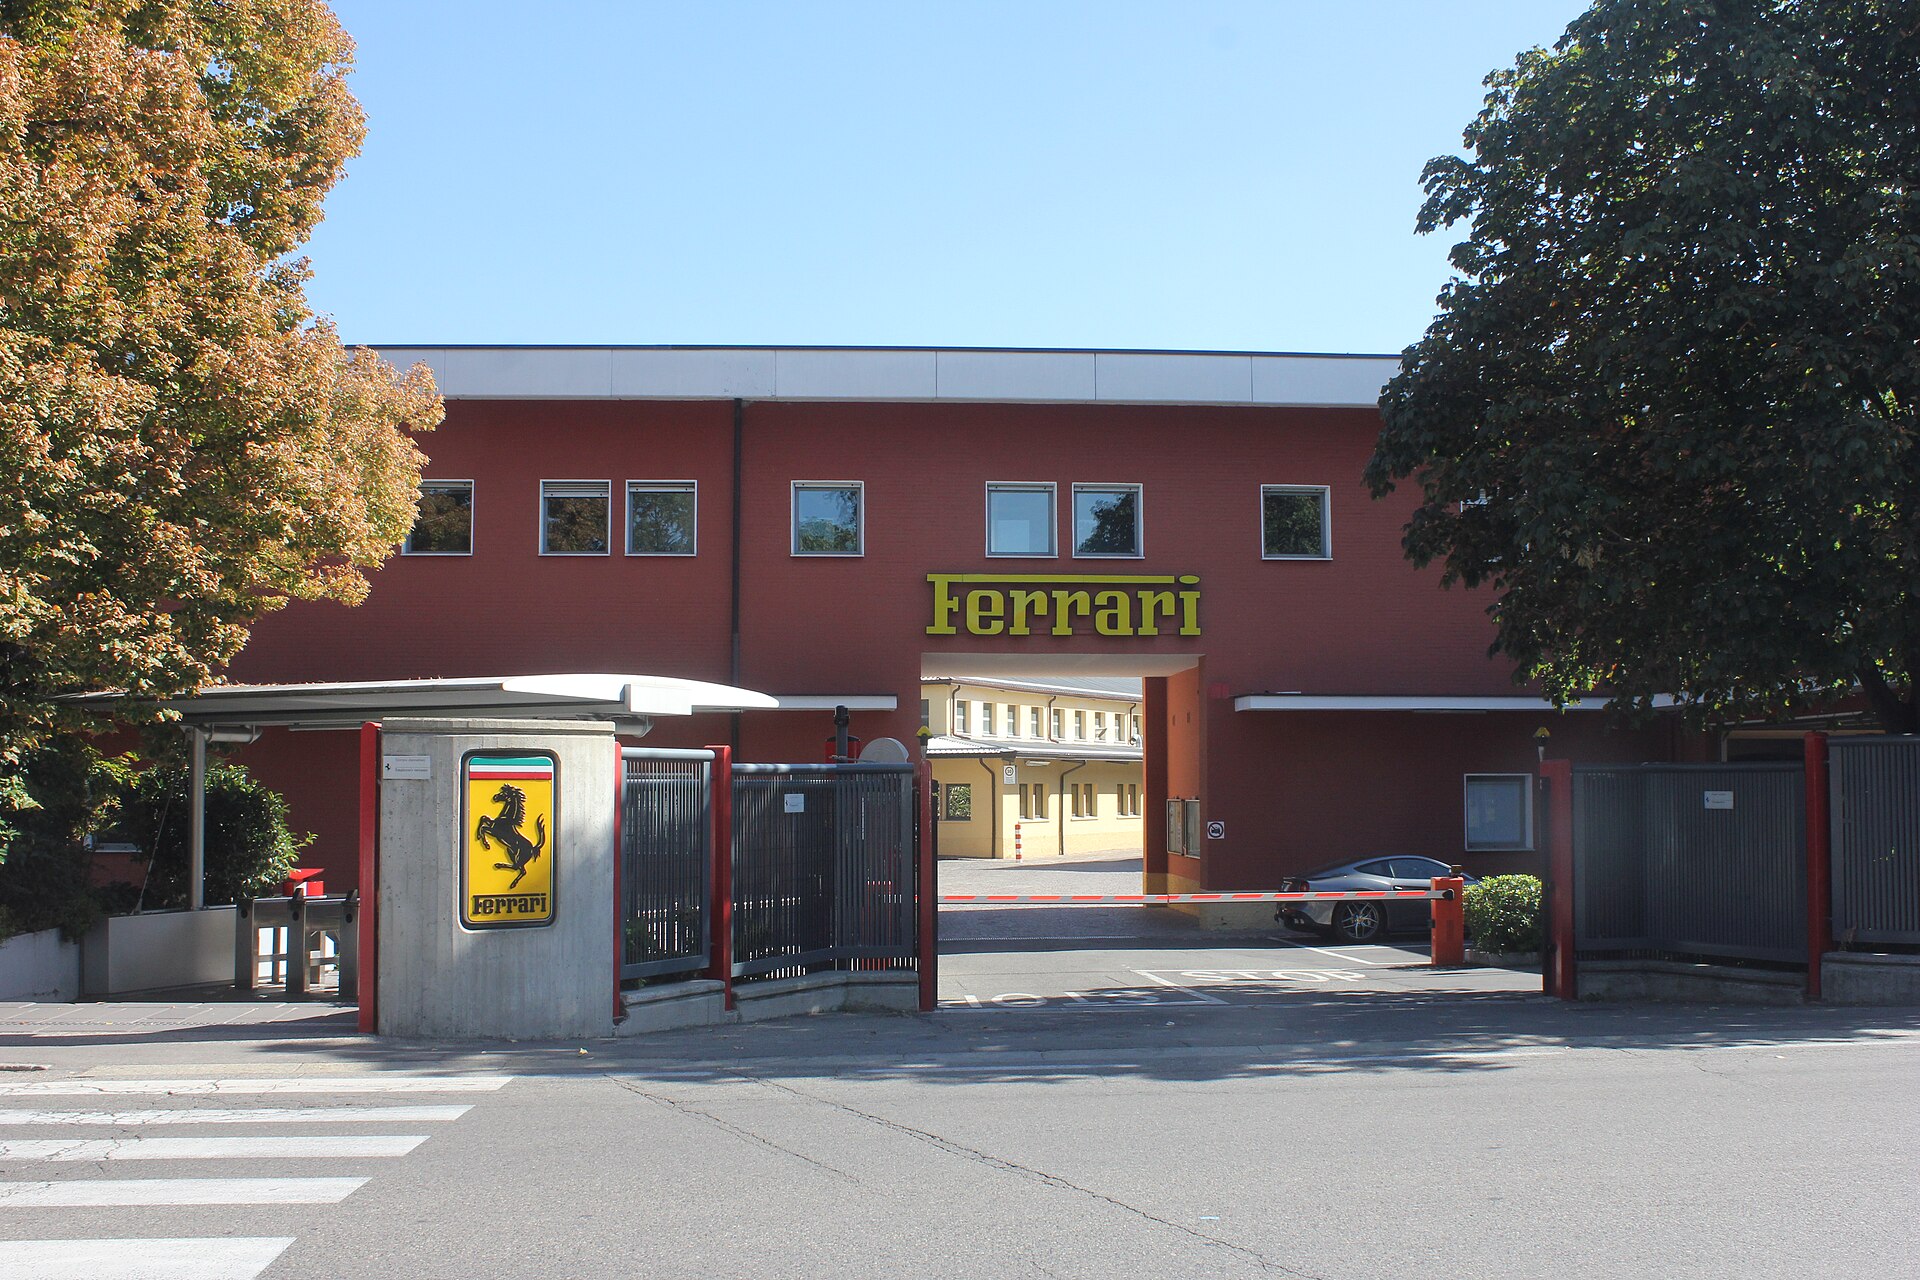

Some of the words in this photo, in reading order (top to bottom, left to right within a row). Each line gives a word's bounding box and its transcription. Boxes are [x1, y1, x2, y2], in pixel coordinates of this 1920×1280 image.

[926, 573, 1201, 636] Ferrari
[472, 893, 547, 915] Ferrari
[1181, 971, 1366, 983] STOP
